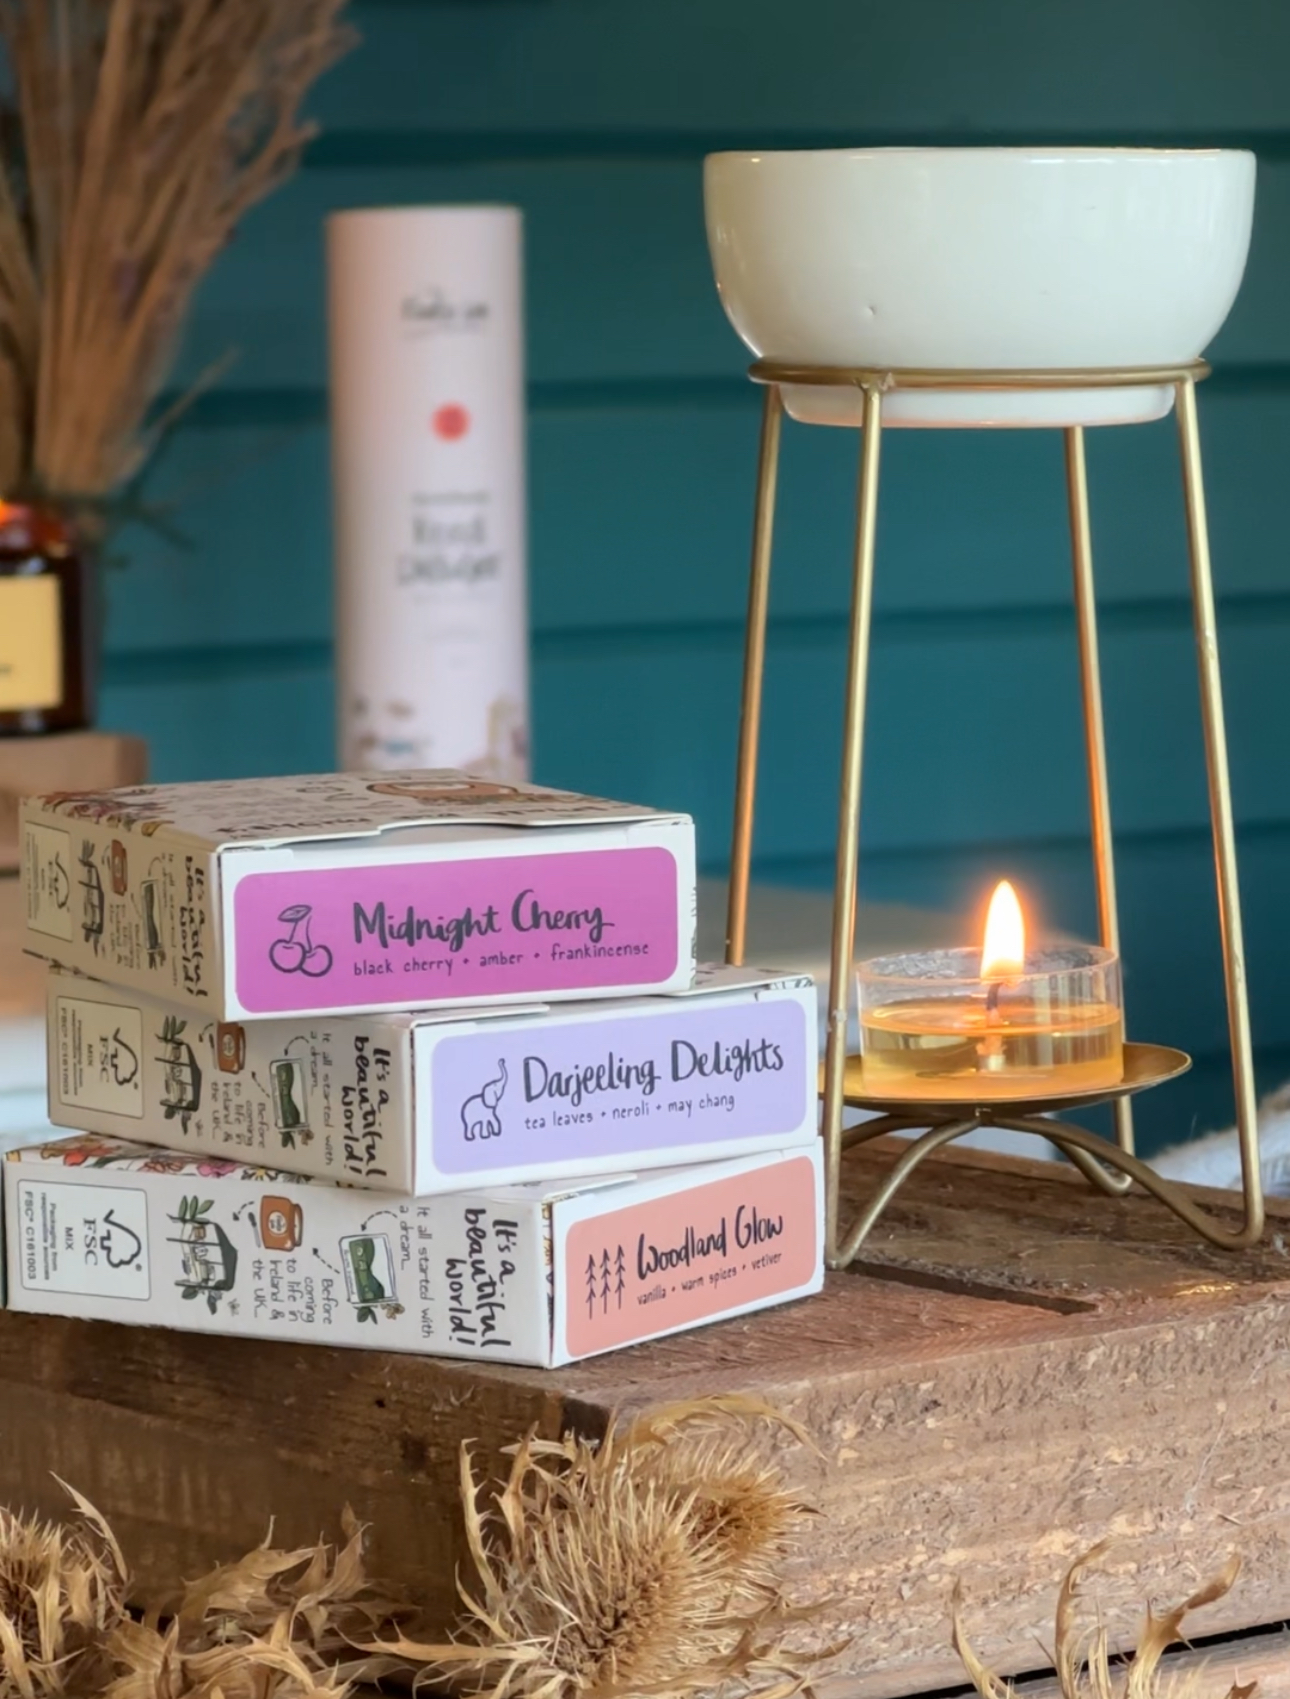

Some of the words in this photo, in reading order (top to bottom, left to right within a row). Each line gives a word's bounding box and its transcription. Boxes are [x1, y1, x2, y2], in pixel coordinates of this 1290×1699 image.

[353, 902, 501, 953] Midnight
[511, 888, 615, 943] Cherry
[354, 961, 394, 977] black
[403, 957, 454, 977] cherry
[479, 951, 524, 967] amber
[550, 942, 650, 961] frankincense
[373, 1048, 391, 1082] It's
[523, 1052, 661, 1107] Darjeeling
[671, 1037, 784, 1083] Delights
[354, 1036, 387, 1177] beautiful
[378, 1089, 389, 1114] a
[525, 1117, 546, 1130] tea
[553, 1110, 594, 1127] leaves
[612, 1100, 650, 1120] neroli
[668, 1098, 693, 1119] may
[699, 1093, 735, 1113] chang
[341, 1086, 363, 1174] world!
[399, 1205, 409, 1213] a
[417, 1206, 430, 1217] It
[65, 1227, 74, 1250] MIX
[83, 1218, 98, 1266] FSC
[417, 1225, 432, 1239] all
[492, 1219, 518, 1253] It's
[637, 1217, 727, 1281] Woodland
[735, 1204, 783, 1250] Glow
[252, 1259, 265, 1280] the
[269, 1260, 284, 1302] Ireland
[286, 1259, 297, 1273] to
[417, 1247, 435, 1301] started
[464, 1208, 511, 1348] beautiful
[499, 1260, 516, 1285] a
[637, 1284, 667, 1305] vanilla
[681, 1276, 704, 1291] warm
[709, 1266, 738, 1290] spices
[751, 1253, 782, 1271] vetiver
[287, 1281, 303, 1302] life
[300, 1276, 317, 1323] coming
[321, 1278, 339, 1325] Before
[445, 1258, 477, 1346] world!
[270, 1309, 285, 1320] &
[288, 1310, 300, 1322] in
[420, 1308, 435, 1339] with
